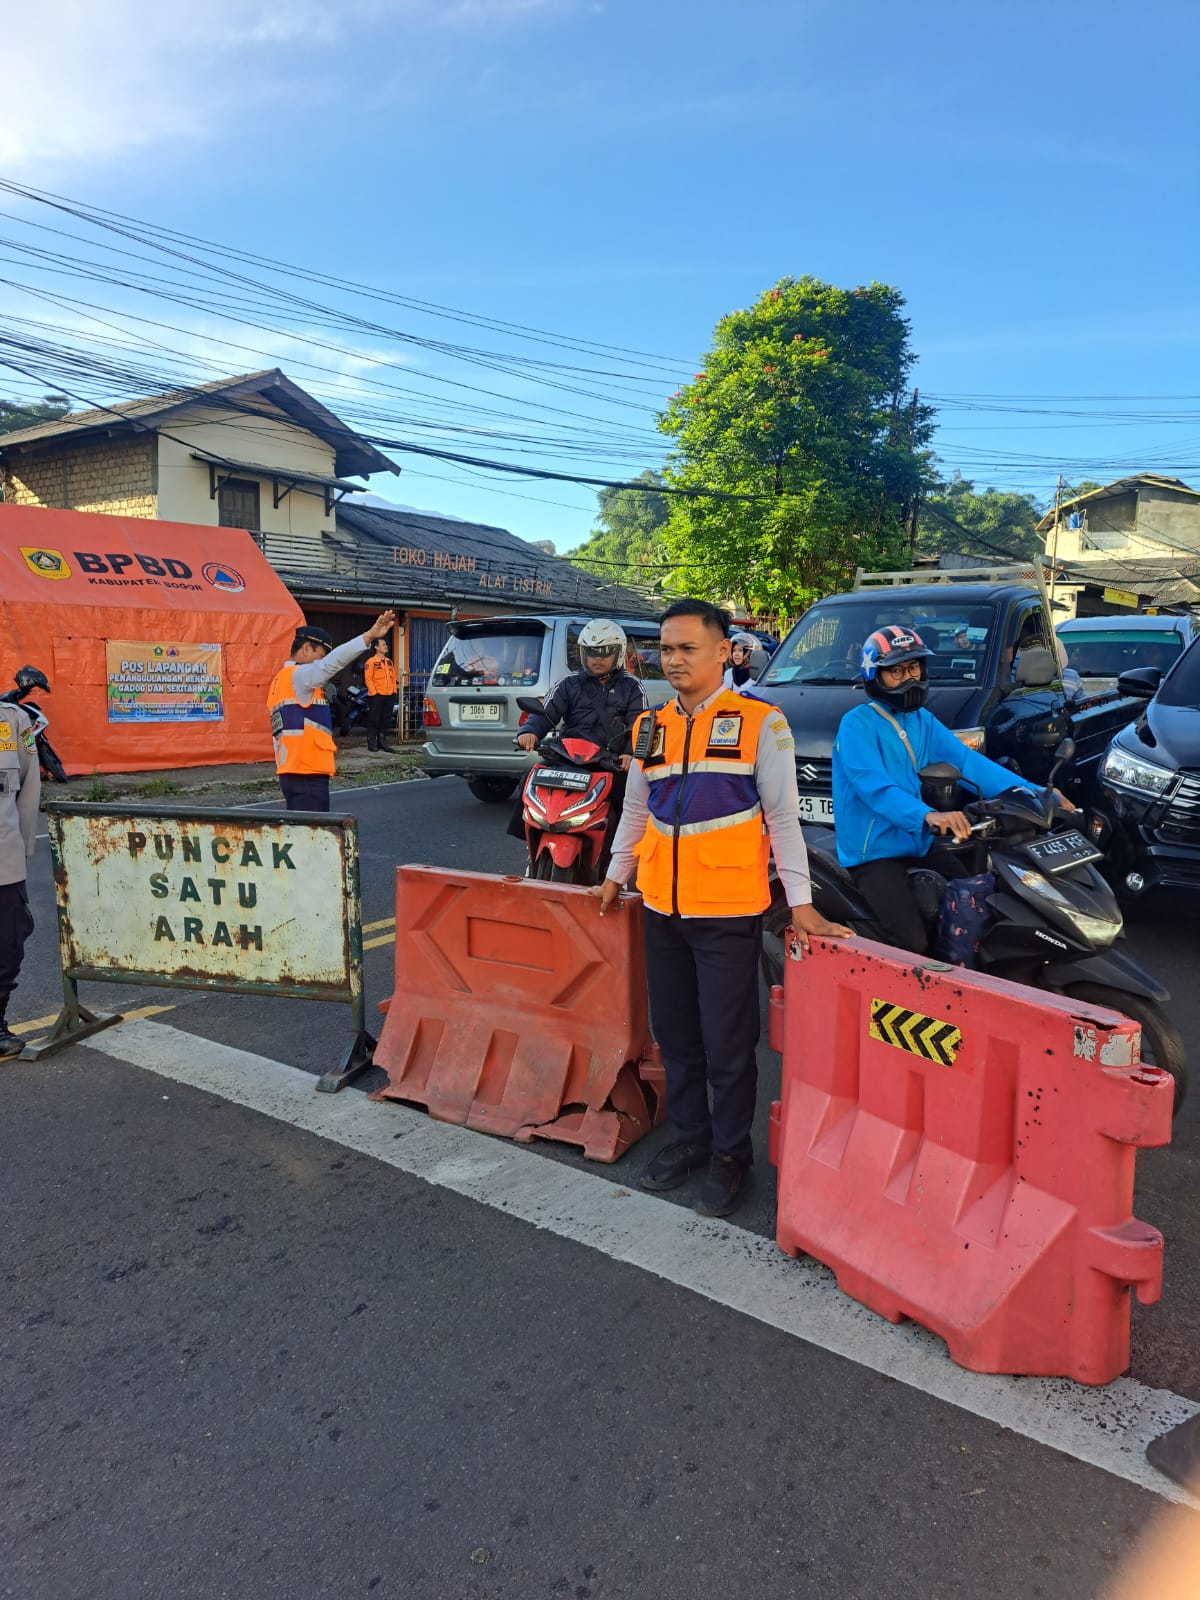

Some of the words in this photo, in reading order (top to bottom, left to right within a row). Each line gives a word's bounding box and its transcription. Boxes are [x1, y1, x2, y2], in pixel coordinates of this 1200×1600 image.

[73, 551, 193, 579] BPBD
[391, 546, 426, 566] TOKO
[433, 551, 476, 574] HAJAH
[163, 581, 204, 591] BOGOR
[479, 574, 507, 589] ALAT
[513, 577, 553, 595] LISTRIK
[121, 661, 144, 673] POS
[147, 661, 208, 674] LAPANGAN
[109, 673, 183, 683] PENANGGULANGAN
[185, 675, 220, 684] BENCANA
[118, 684, 145, 693] GADOG
[147, 684, 165, 693] DAN
[167, 684, 213, 693] SEKITARNYA
[127, 831, 297, 870] PUNCAK
[149, 872, 258, 909] SATU
[153, 915, 264, 951] ARAH
[1034, 930, 1067, 950] HONDA
